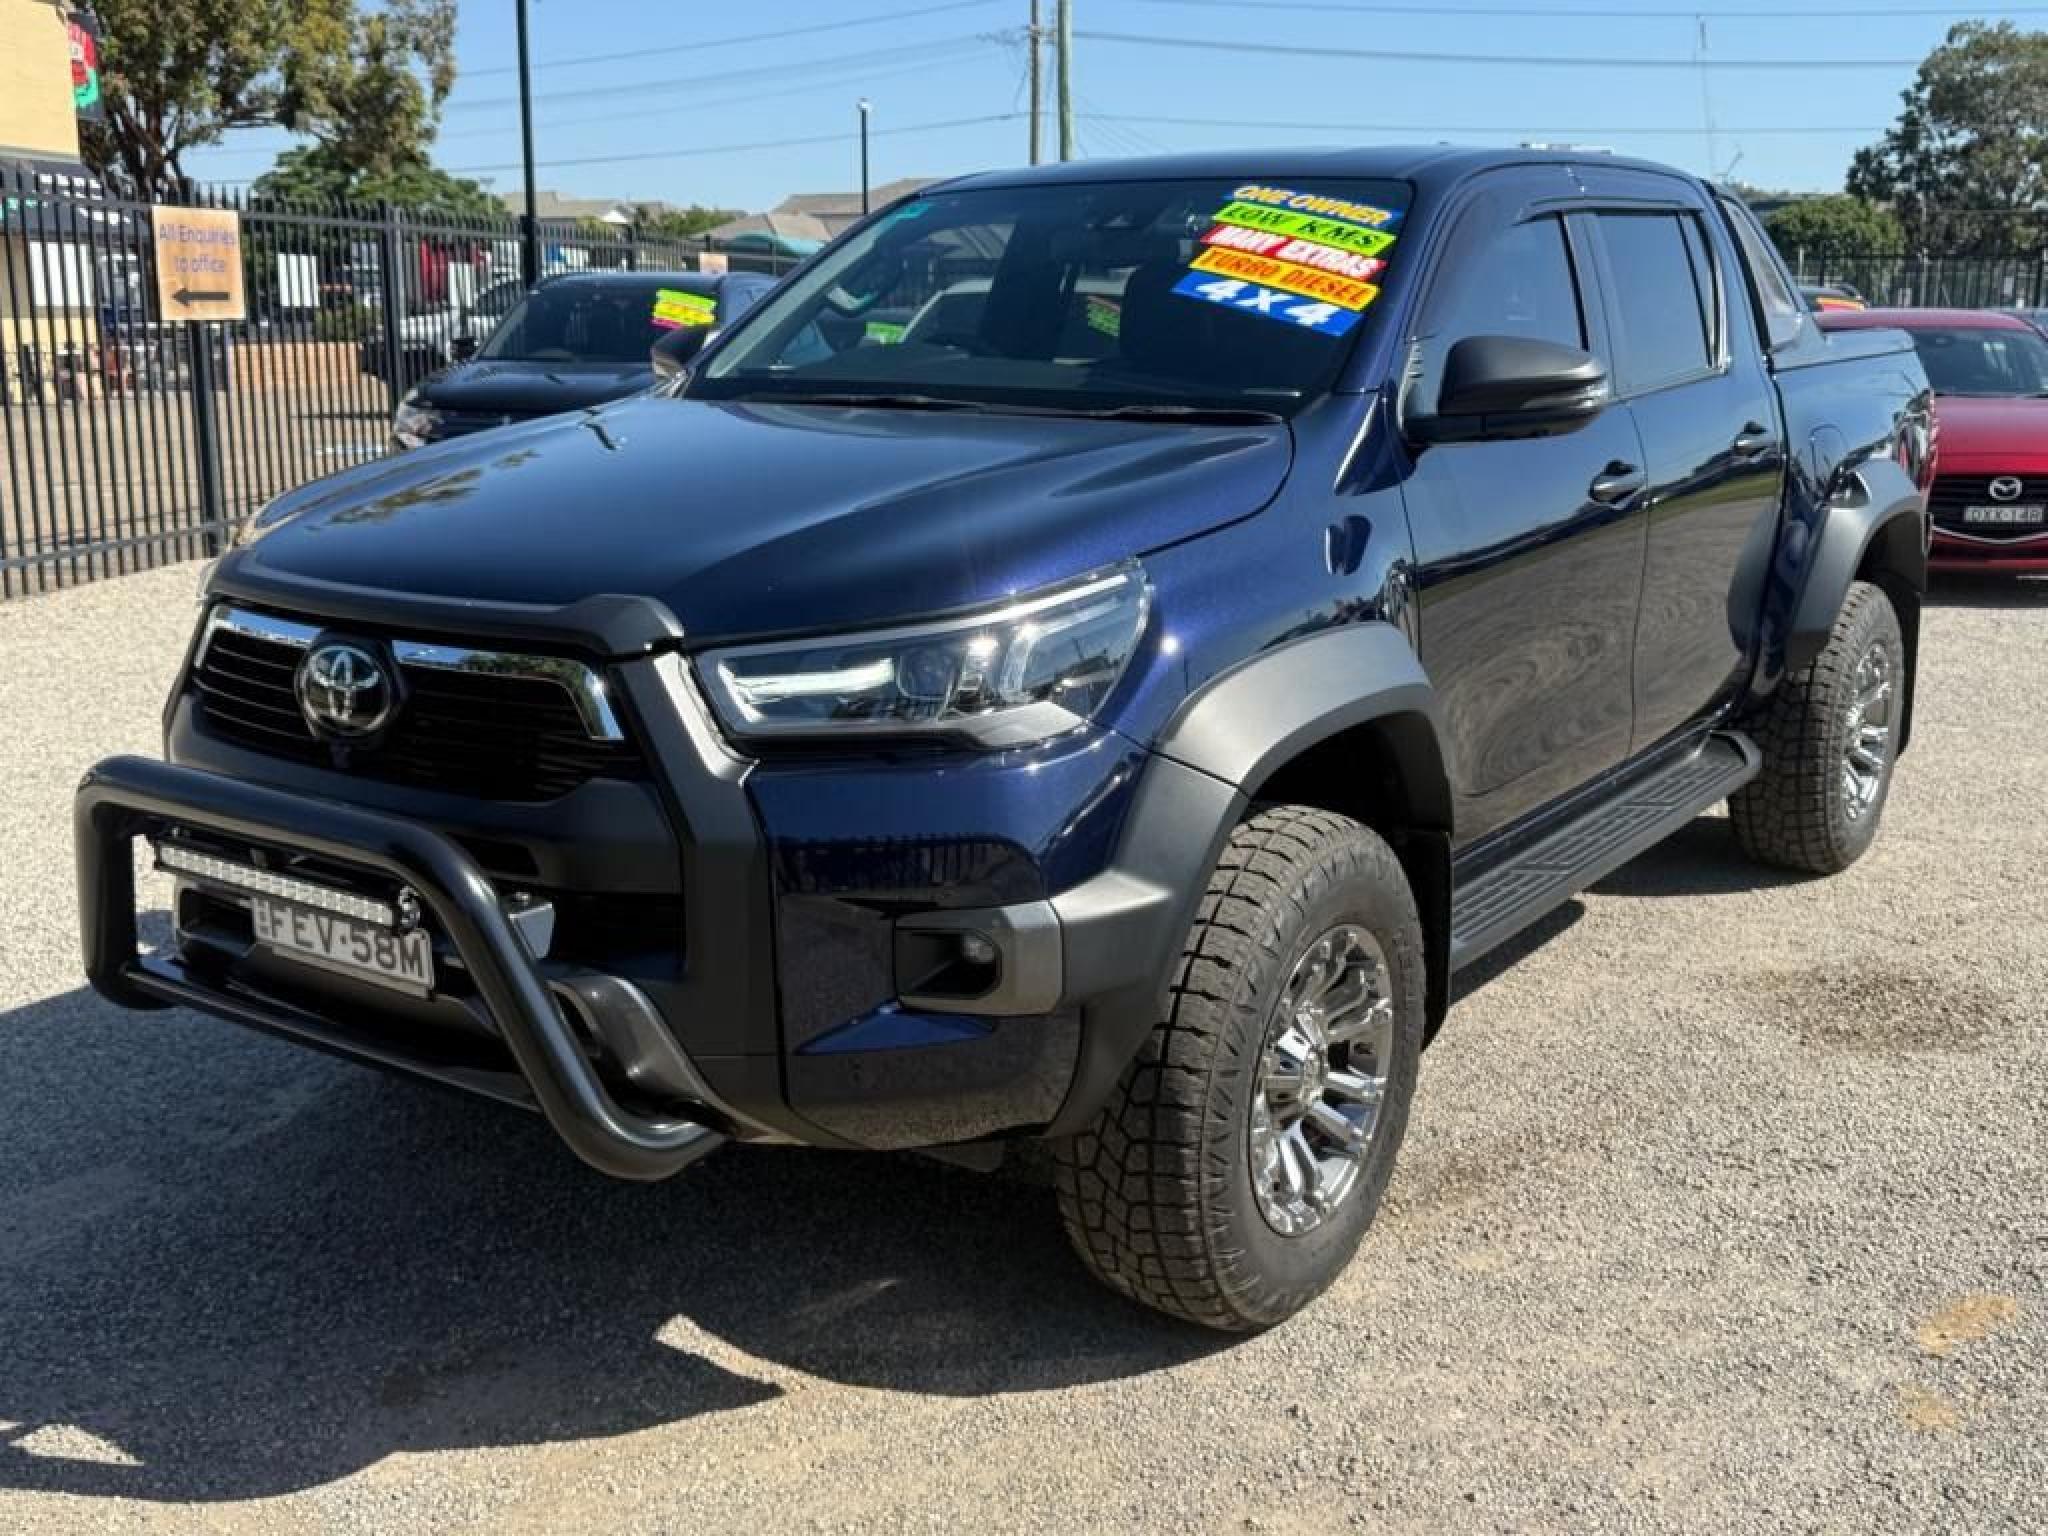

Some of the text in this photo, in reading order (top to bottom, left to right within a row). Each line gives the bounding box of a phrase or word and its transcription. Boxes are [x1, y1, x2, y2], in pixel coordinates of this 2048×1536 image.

[1224, 204, 1381, 247] LOW KMS
[1233, 185, 1393, 226] ONE OWNER
[159, 223, 175, 240] All
[175, 254, 225, 272] to office
[1199, 250, 1370, 305] TURBO DIESEL
[1276, 238, 1377, 278] EXTRAS
